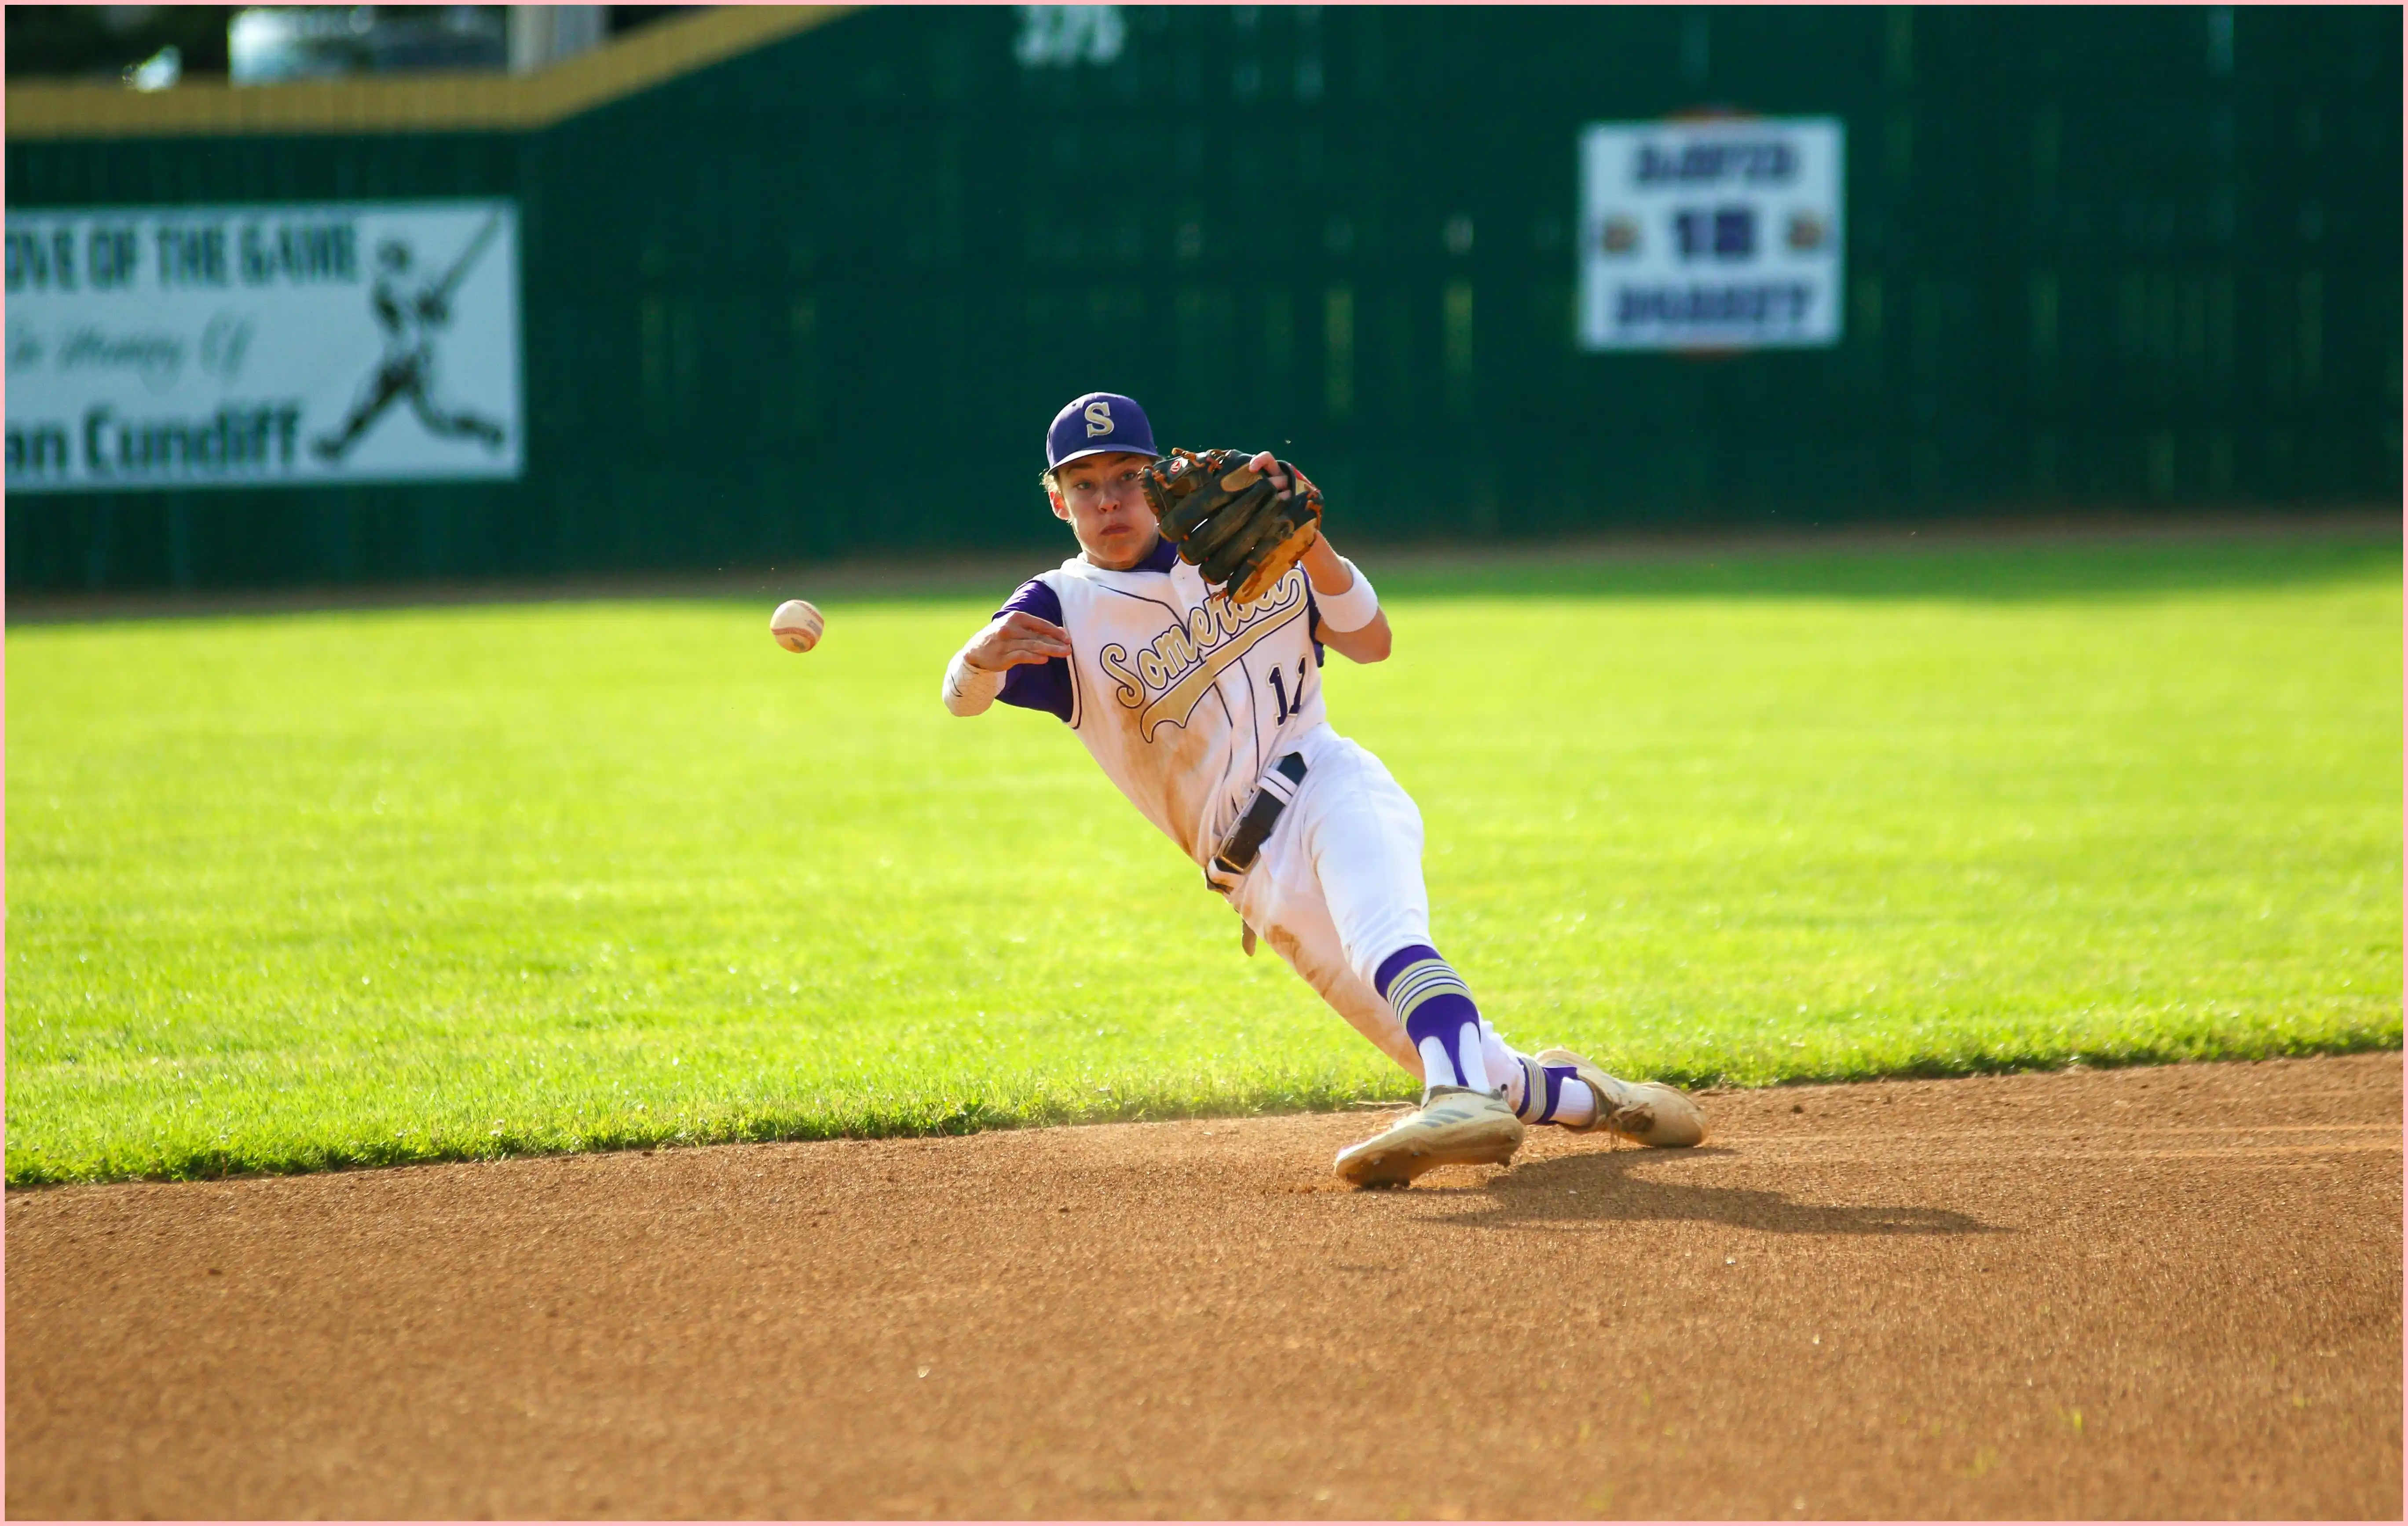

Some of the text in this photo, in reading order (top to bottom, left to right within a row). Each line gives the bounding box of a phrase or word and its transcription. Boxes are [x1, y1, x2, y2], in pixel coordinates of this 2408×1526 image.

[157, 222, 226, 286] THE
[239, 220, 357, 285] GAME
[1084, 402, 1114, 438] S
[1267, 653, 1306, 729] 11
